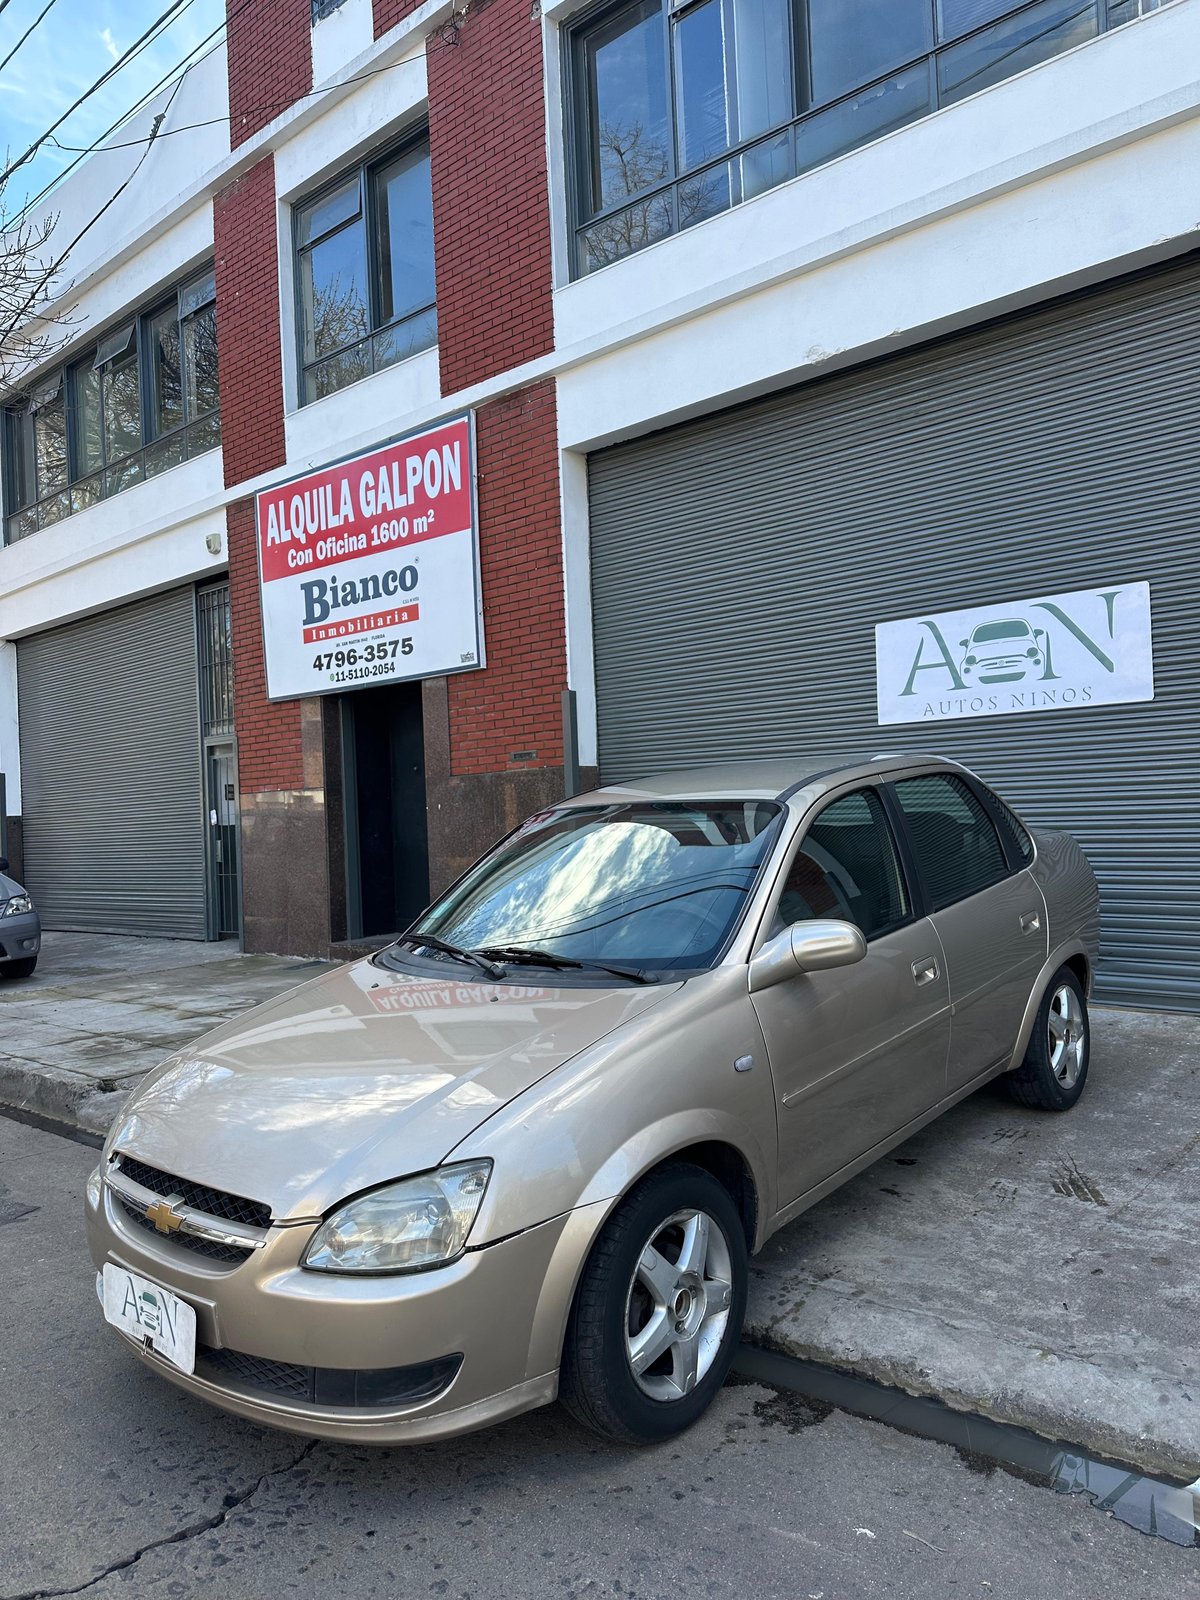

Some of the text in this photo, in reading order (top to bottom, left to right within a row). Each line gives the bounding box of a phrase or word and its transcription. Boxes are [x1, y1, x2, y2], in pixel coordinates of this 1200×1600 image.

[267, 440, 462, 547] ALQUILA GALPON
[287, 548, 313, 568] Con
[316, 532, 367, 560] Oficina
[370, 517, 409, 547] 1600
[300, 564, 419, 626] Bianco
[311, 610, 409, 641] Inmobiliaria
[312, 637, 414, 672] 4796-3575
[335, 661, 396, 682] 11-5110-2054
[923, 686, 1092, 716] AUTOS NINOS
